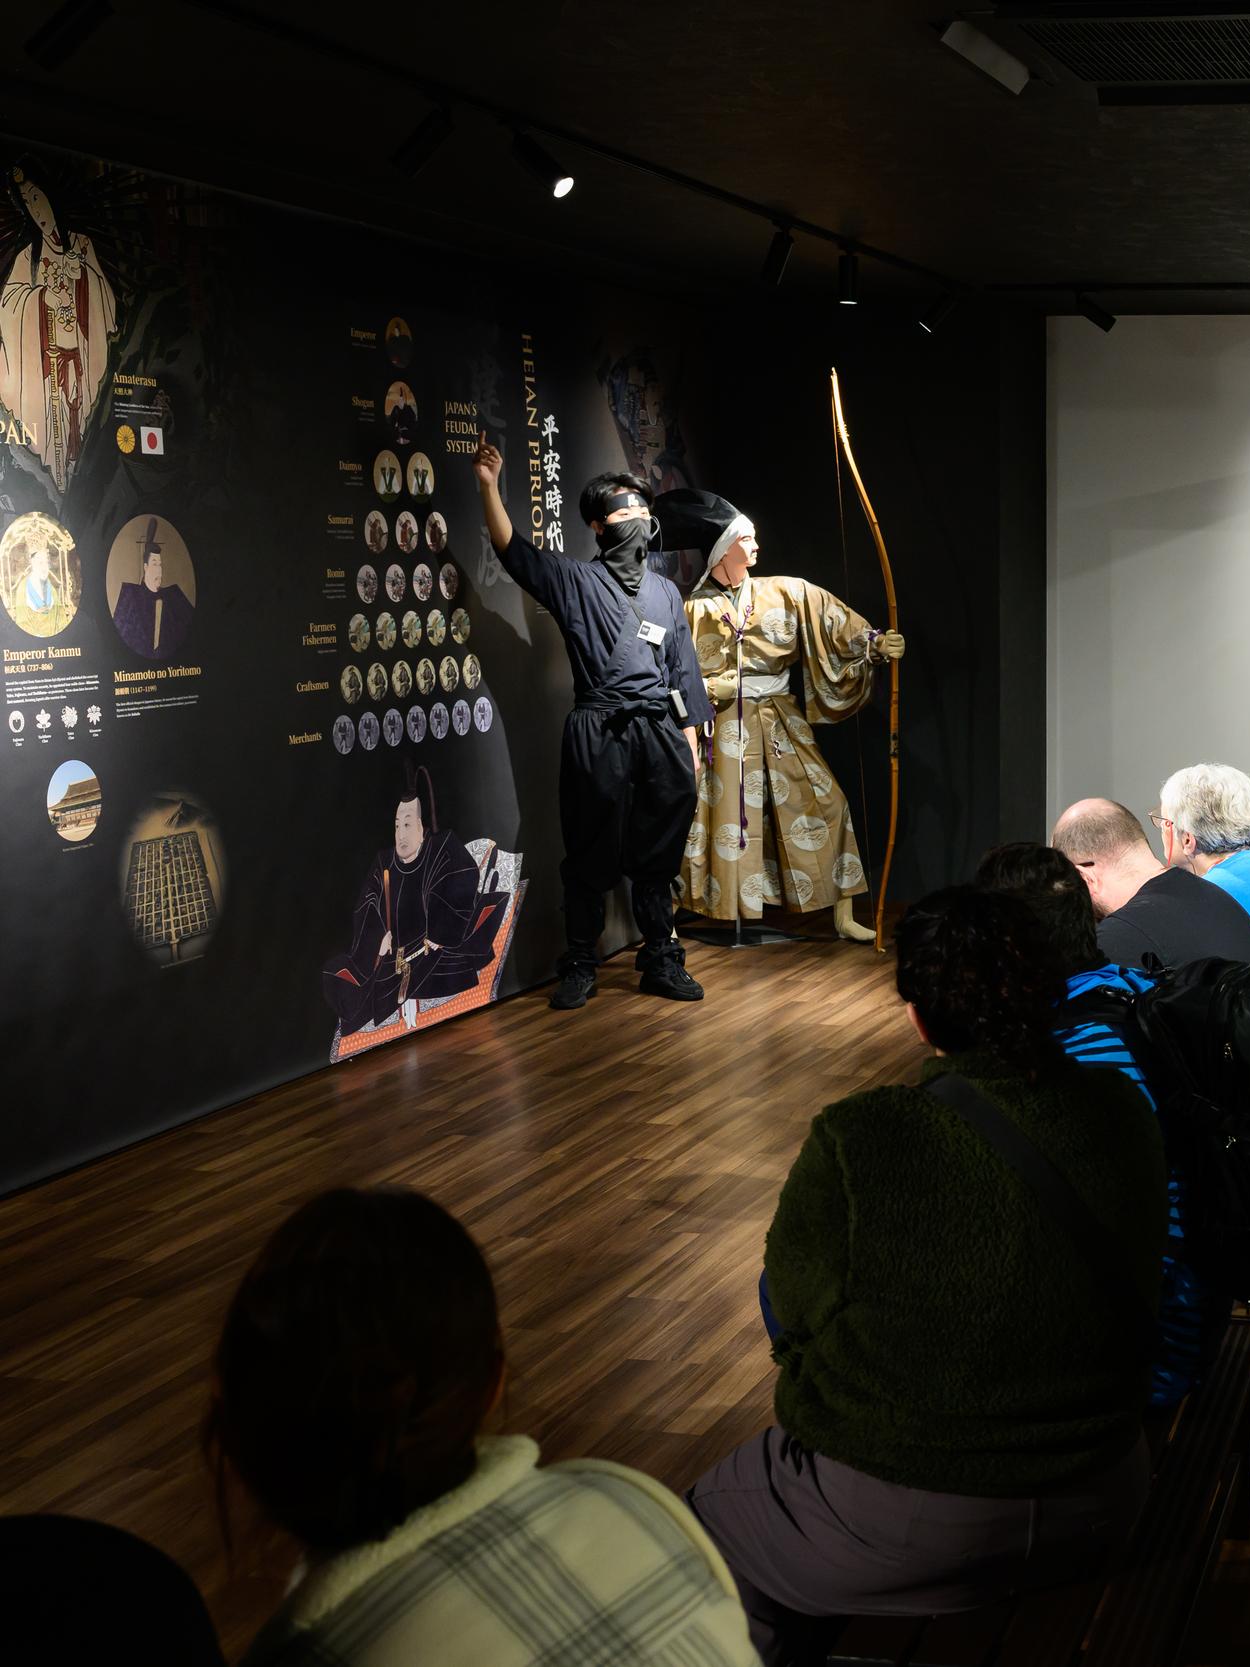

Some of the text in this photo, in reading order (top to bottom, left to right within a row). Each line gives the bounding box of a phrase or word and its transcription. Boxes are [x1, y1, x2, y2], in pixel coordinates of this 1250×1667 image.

[113, 372, 157, 388] Amaterasu
[444, 400, 478, 417] JAPAN'S
[444, 420, 479, 436] FEUDAL
[446, 439, 479, 454] SYSTEM
[521, 333, 545, 551] HEIAN PERIOD
[541, 413, 564, 553] 平安時代
[327, 514, 354, 525] Samurai
[327, 567, 345, 578] Ronin
[309, 622, 337, 633] Farmers
[302, 635, 337, 647] Fishermen
[3, 646, 82, 664] Emperor Kanmu
[113, 665, 202, 683] Minamoto no Yoritomo
[296, 680, 330, 693] Craftsmen
[288, 731, 323, 746] Merchants
